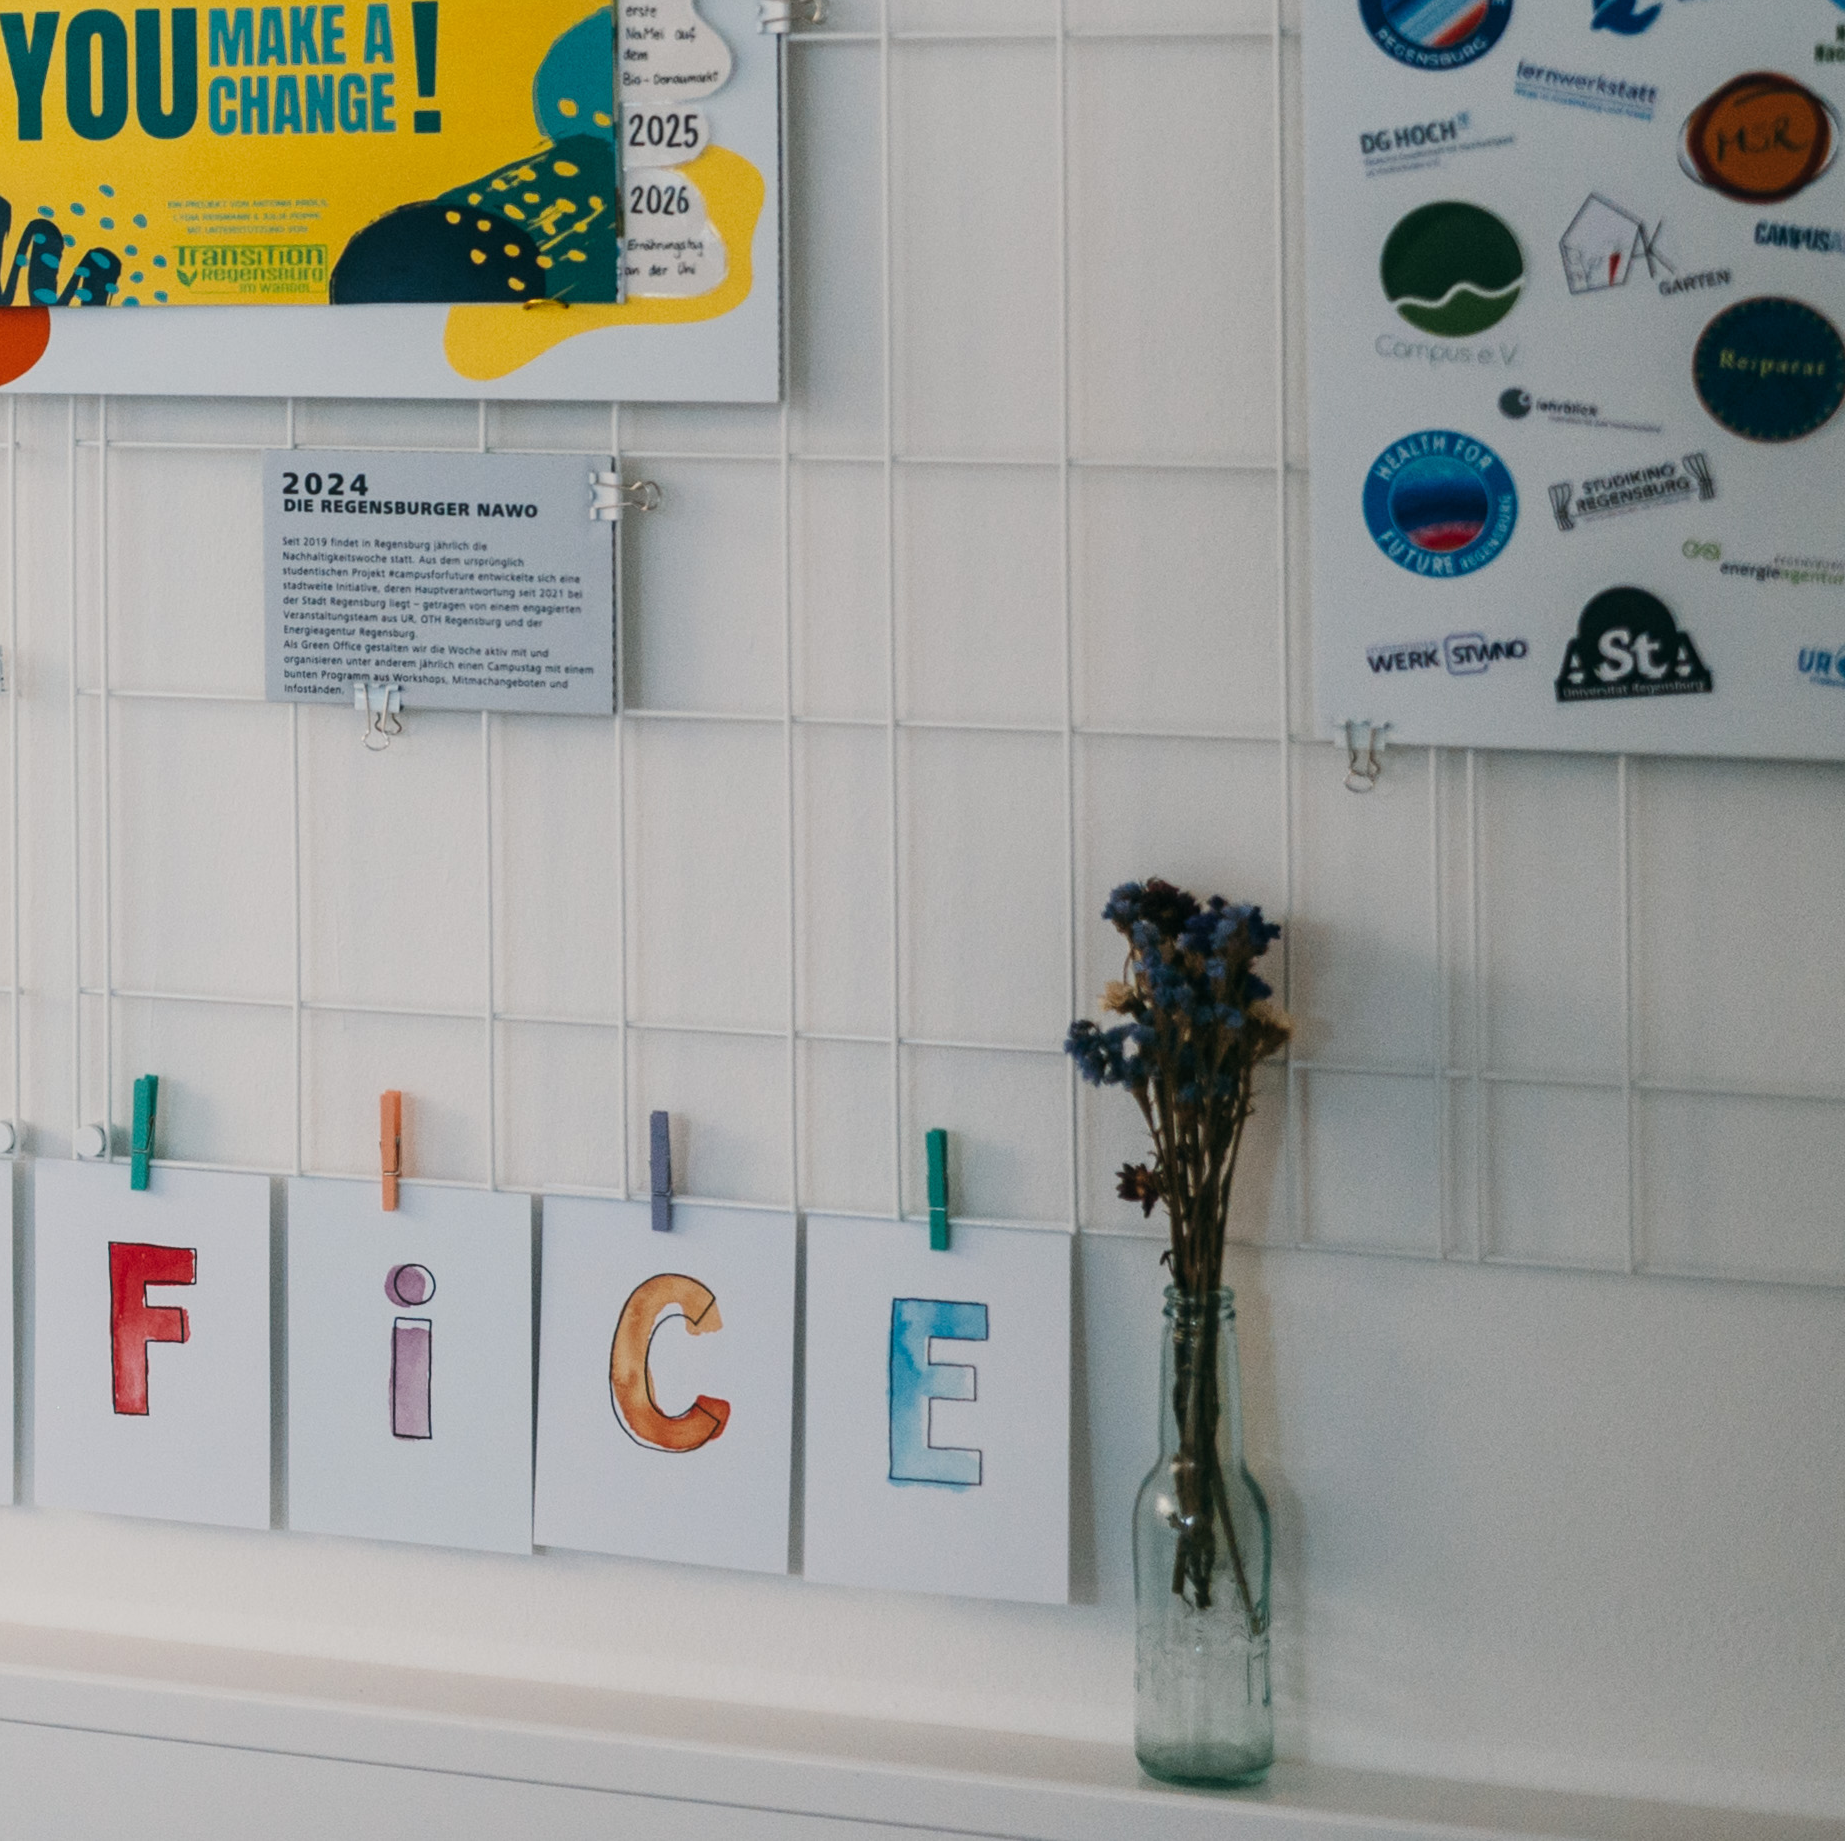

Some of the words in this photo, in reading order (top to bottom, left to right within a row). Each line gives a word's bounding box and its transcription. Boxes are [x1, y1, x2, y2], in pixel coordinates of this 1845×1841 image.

[207, 3, 347, 69] MAKE
[363, 2, 396, 65] A
[1516, 59, 1657, 104] lernwerkstatt
[207, 71, 399, 137] CHANGE
[628, 113, 700, 148] 2025
[630, 185, 690, 215] 2026
[1658, 268, 1733, 296] GARTEN
[1374, 434, 1447, 482] HEALTH
[1453, 438, 1495, 473] FOR
[282, 471, 369, 497] 2024
[1575, 476, 1692, 514] REGENSBURG
[1581, 460, 1677, 495] STUDIKINO
[283, 498, 315, 513] DIE
[320, 499, 471, 518] REGENSBURGER
[476, 503, 539, 519] NAWO
[282, 536, 300, 547] Seit
[303, 537, 328, 547] 2019
[330, 537, 359, 547] findet
[362, 538, 371, 547] in
[374, 539, 431, 551] Regensburg
[472, 542, 488, 551] die
[1377, 529, 1455, 576] FUTURE
[301, 640, 330, 650] Green
[332, 641, 362, 651] Office
[364, 643, 409, 654] gestalten
[1366, 648, 1440, 675] WERK
